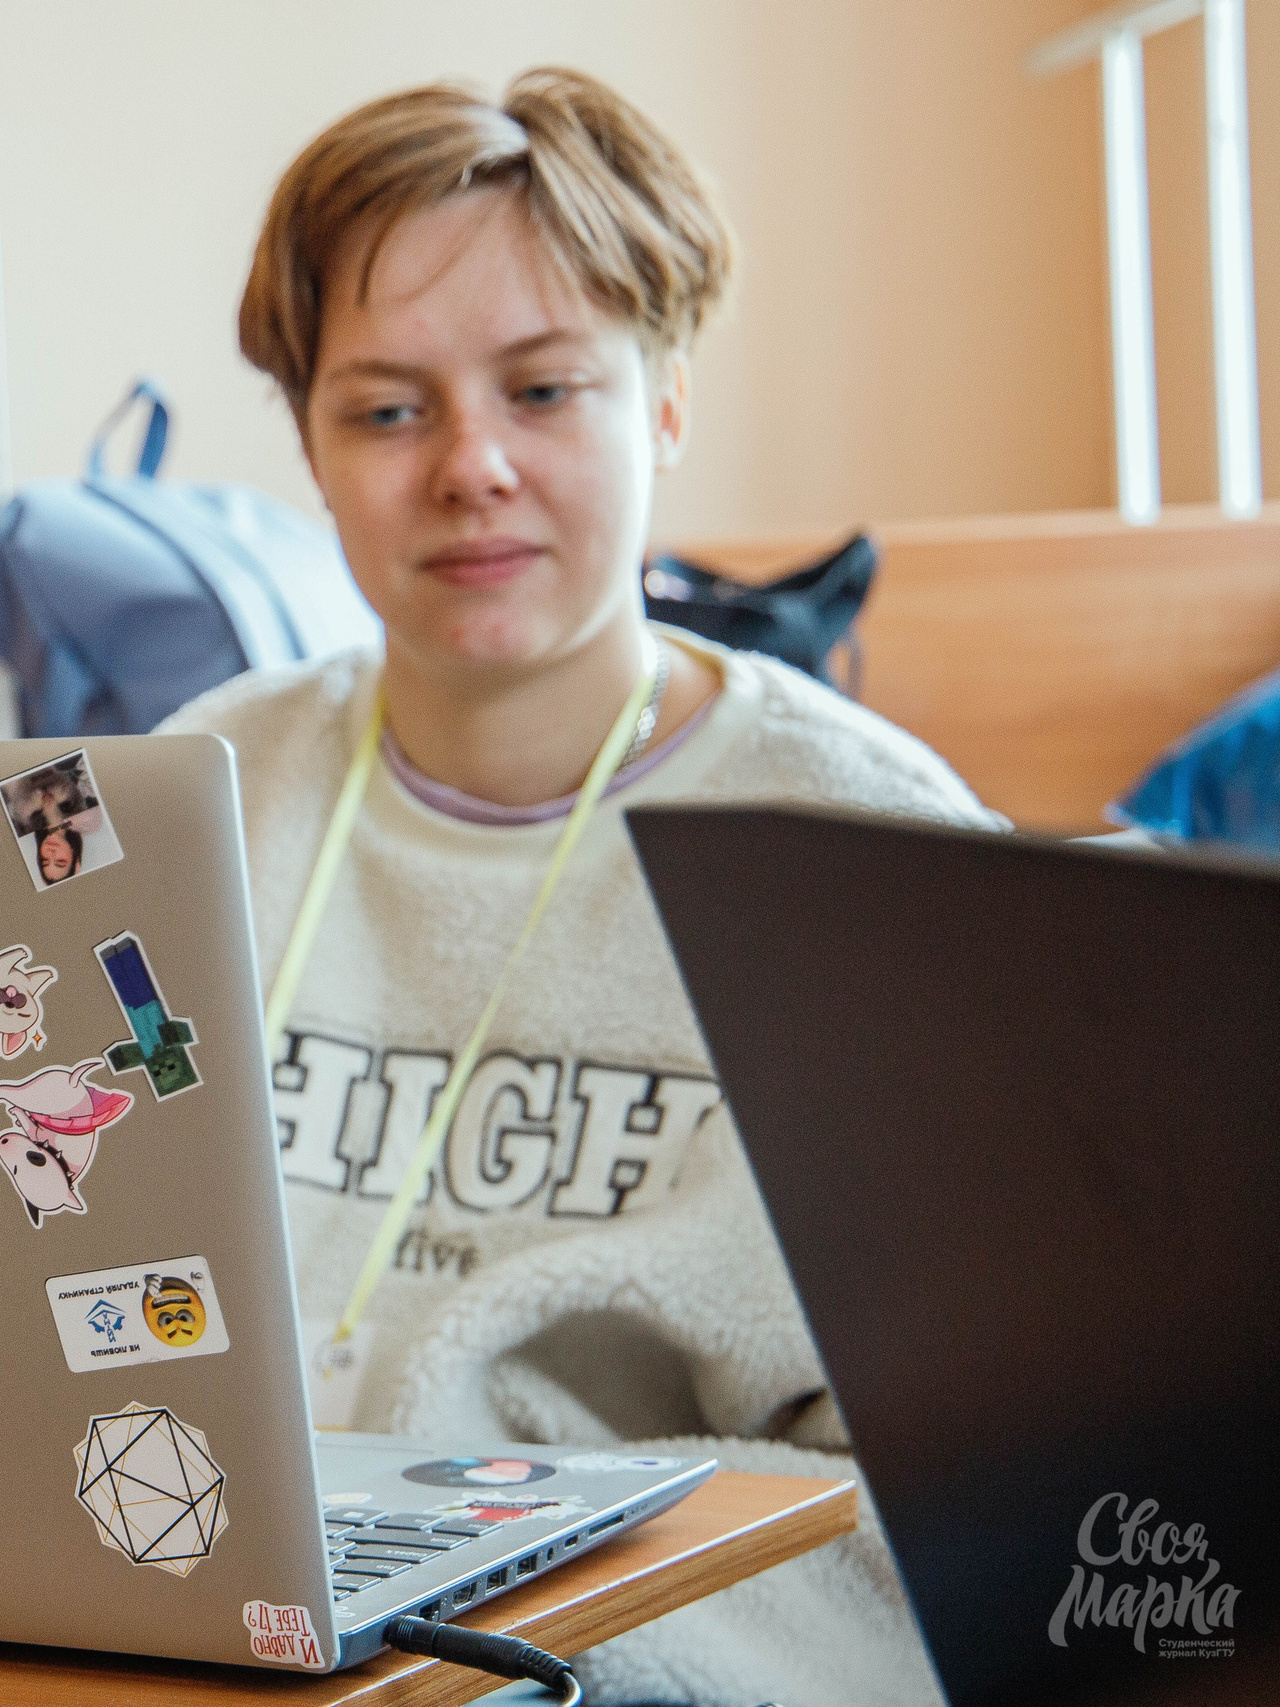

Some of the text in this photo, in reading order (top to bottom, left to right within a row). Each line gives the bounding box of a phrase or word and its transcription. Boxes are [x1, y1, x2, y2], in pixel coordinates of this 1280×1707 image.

[272, 1028, 723, 1218] HIGH
[58, 1282, 139, 1299] УДАЛЯЙ СТРАНИЧКУ
[90, 1346, 127, 1356] ЛЮБИШЬ
[274, 1608, 310, 1637] ТЕБЕ
[253, 1633, 320, 1663] И ДАВНО
